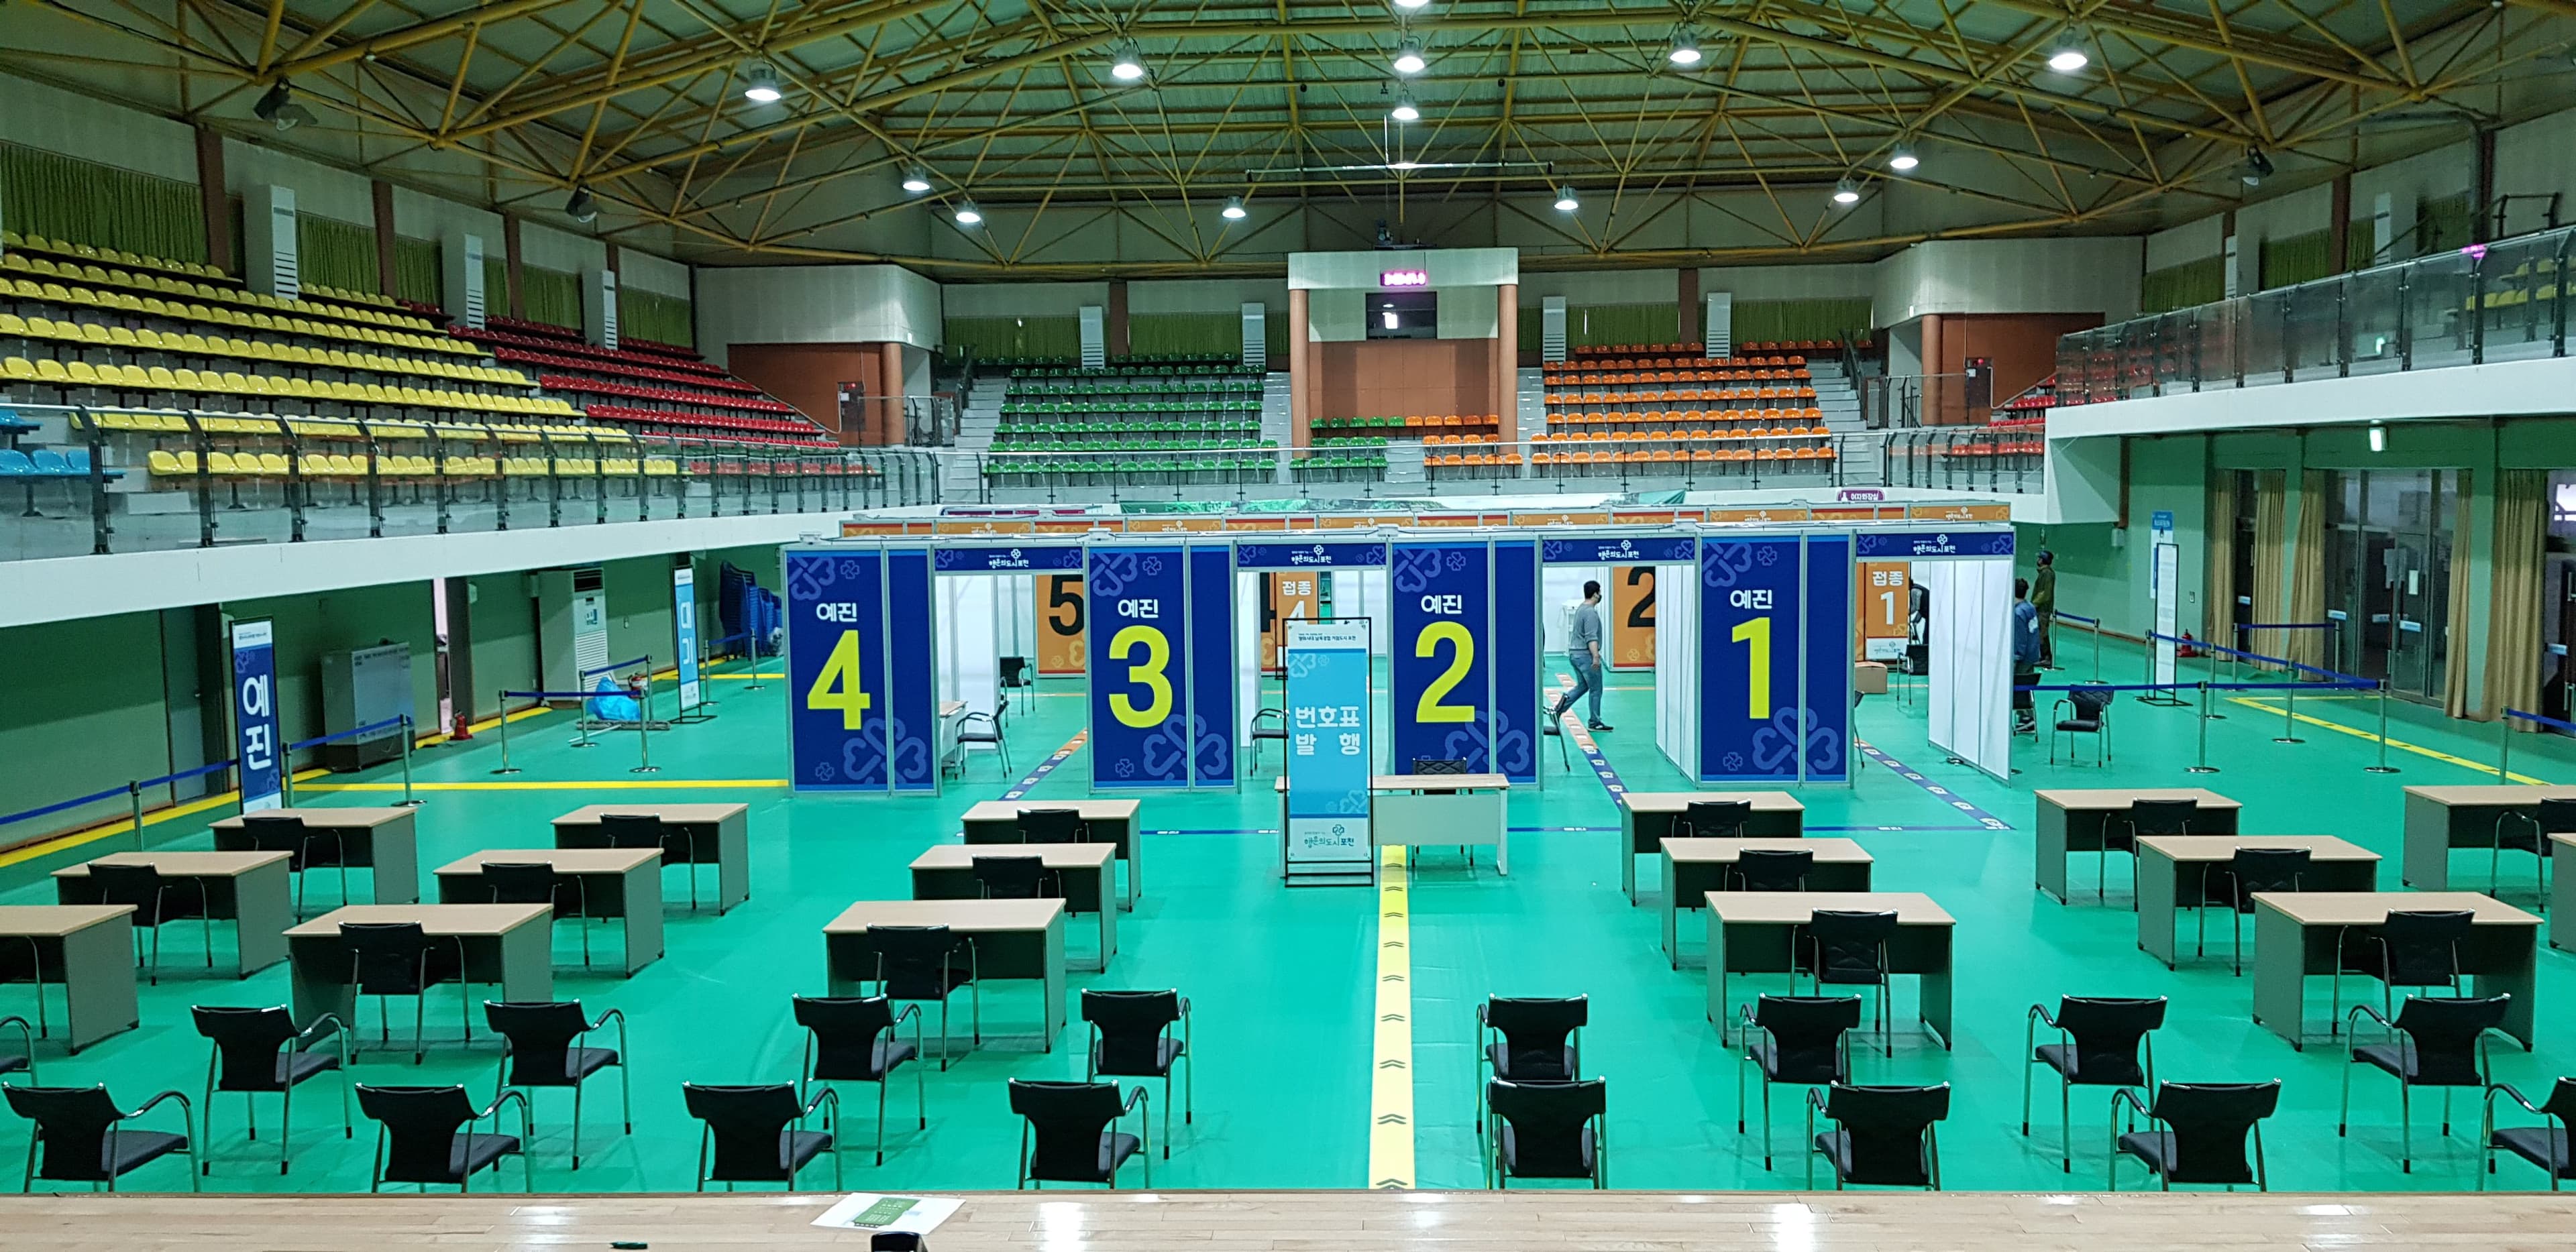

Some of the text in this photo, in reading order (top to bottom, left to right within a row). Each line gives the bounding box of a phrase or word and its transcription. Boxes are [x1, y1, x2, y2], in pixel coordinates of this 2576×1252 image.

[1282, 581, 1311, 595] 접종
[1872, 571, 1904, 587] 접종
[816, 602, 857, 622] 예진
[1049, 575, 1084, 636] 5
[1118, 598, 1159, 618] 예진
[1421, 595, 1462, 614] 예진
[1627, 567, 1656, 627] 2
[1729, 589, 1772, 609] 예진
[1880, 591, 1894, 625] 1
[808, 630, 870, 730] 4
[1109, 626, 1173, 728] 3
[1416, 622, 1475, 722] 2
[1732, 617, 1770, 719] 1
[243, 674, 272, 770] 예진
[1295, 705, 1360, 728] 번호표
